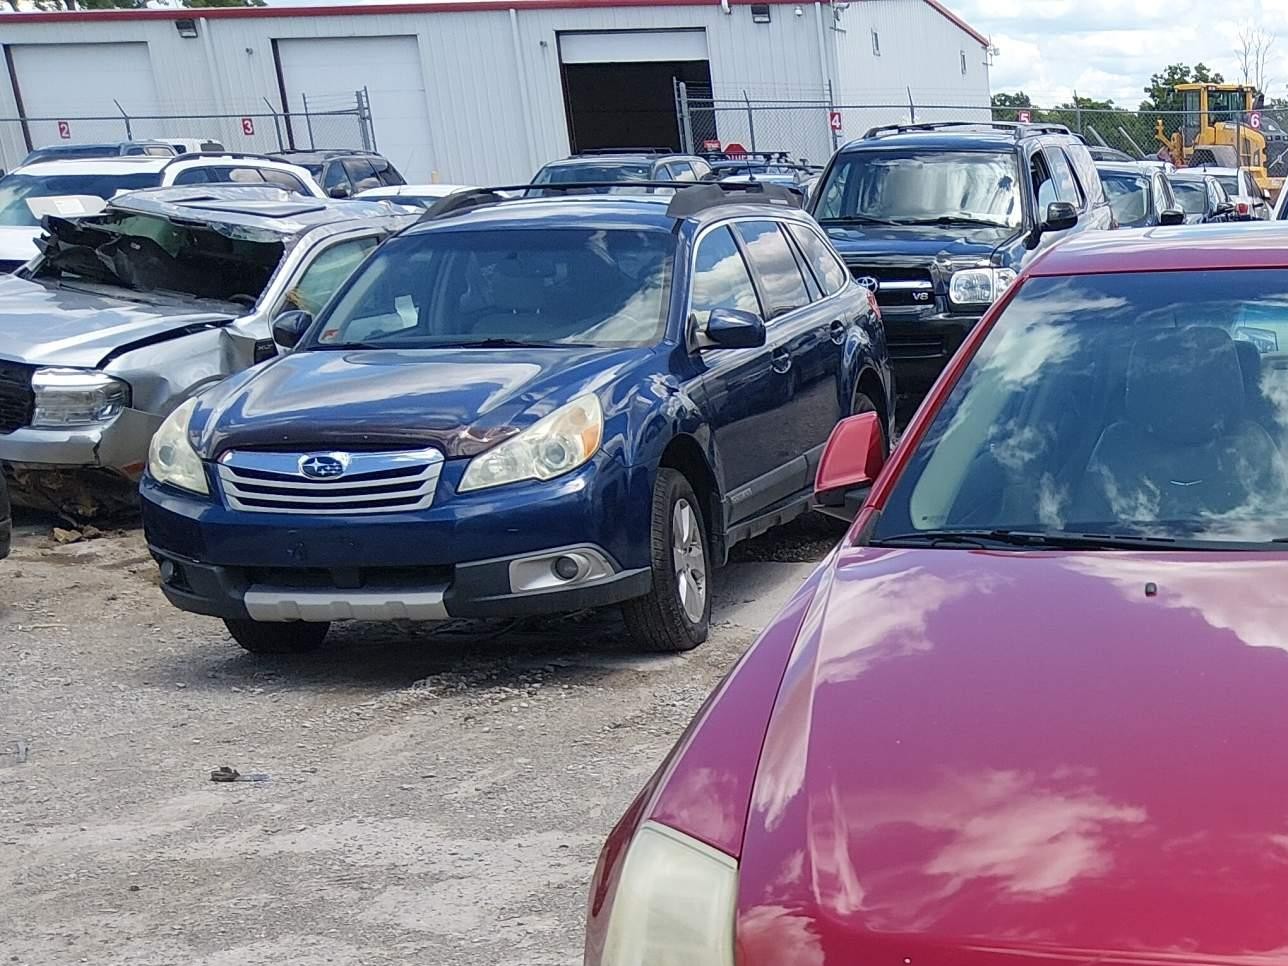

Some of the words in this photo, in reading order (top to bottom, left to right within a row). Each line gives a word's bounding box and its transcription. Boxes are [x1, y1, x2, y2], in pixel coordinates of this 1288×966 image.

[243, 120, 253, 134] 3
[831, 114, 841, 128] 4
[1250, 113, 1260, 128] 6
[60, 123, 69, 137] 2
[912, 292, 929, 300] V8
